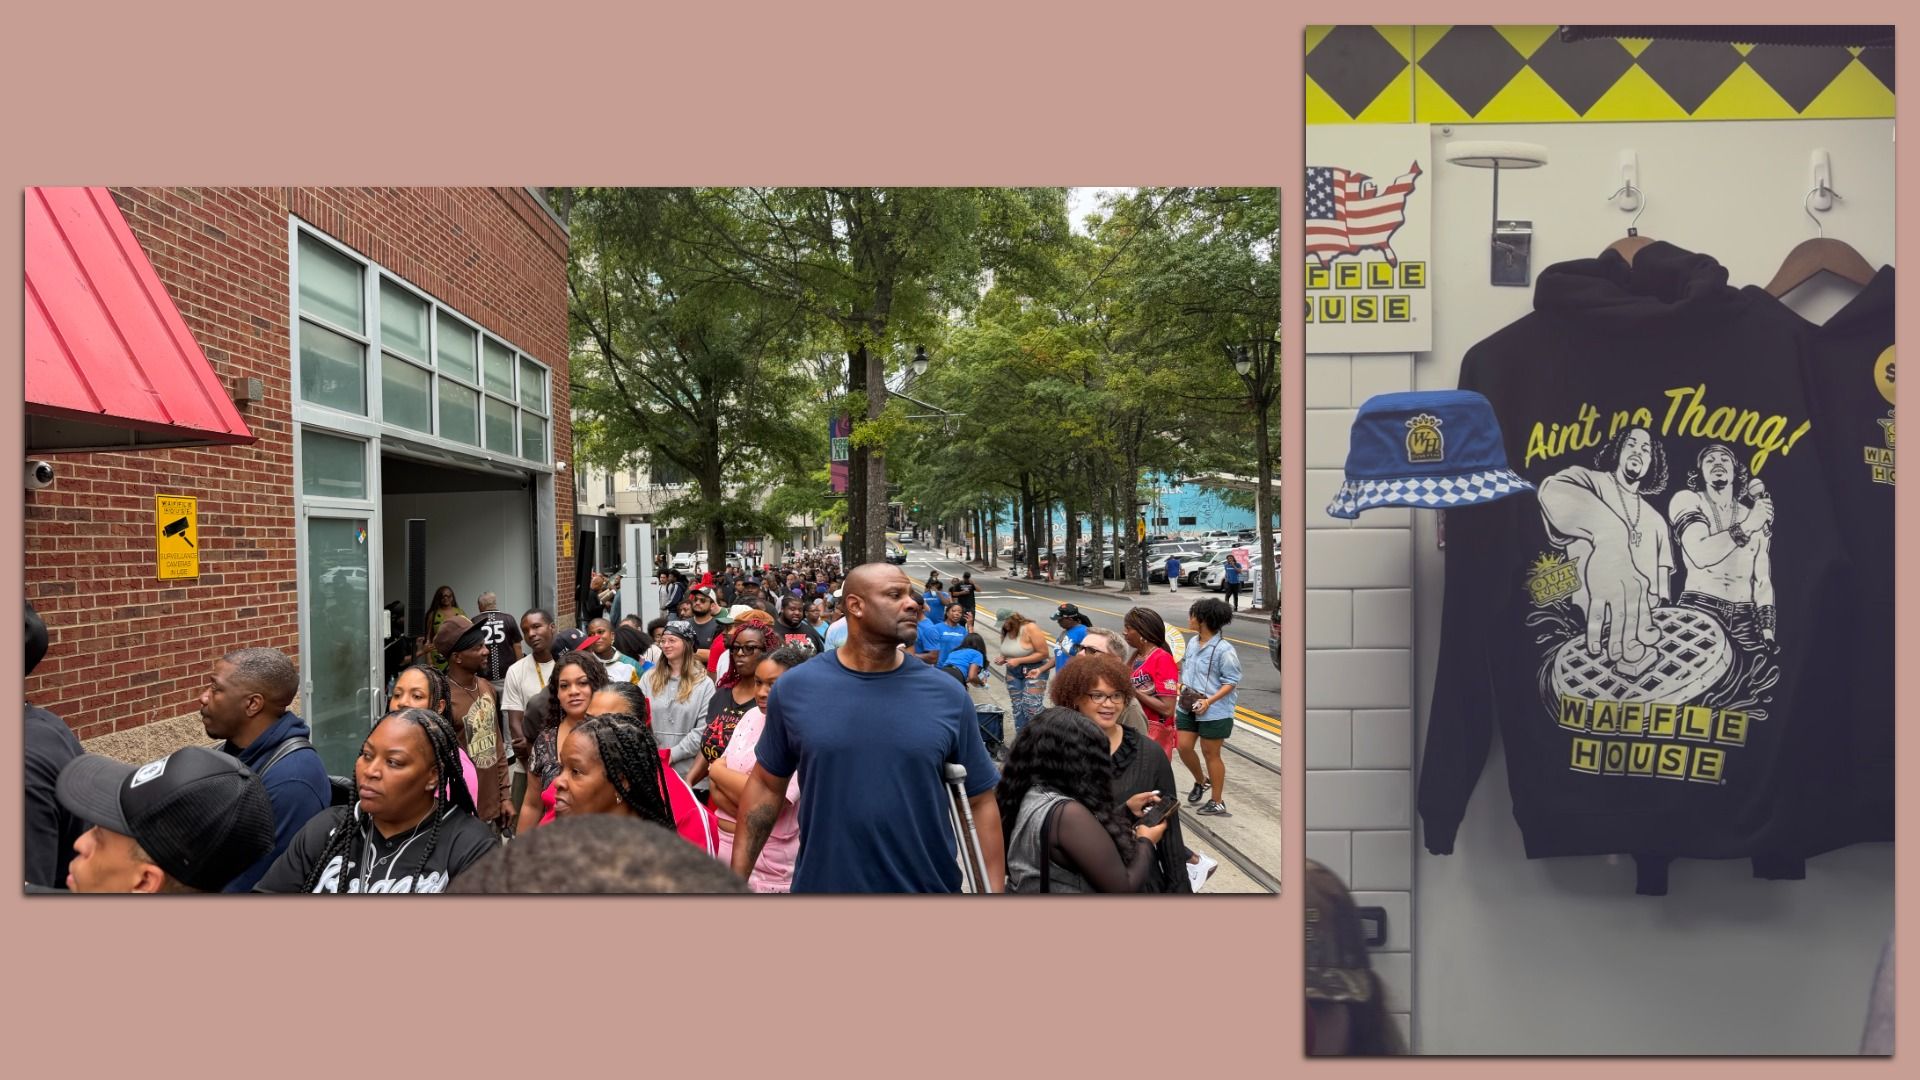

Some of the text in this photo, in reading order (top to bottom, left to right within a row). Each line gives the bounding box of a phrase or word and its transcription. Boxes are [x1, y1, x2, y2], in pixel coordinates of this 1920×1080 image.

[1308, 264, 1422, 286] FFLE
[1525, 383, 1812, 476] Ain't no Thang!
[1531, 565, 1575, 591] OUT
[480, 624, 505, 645] 25
[1562, 699, 1742, 739] WAFFLE
[1575, 741, 1719, 777] HOUSE
